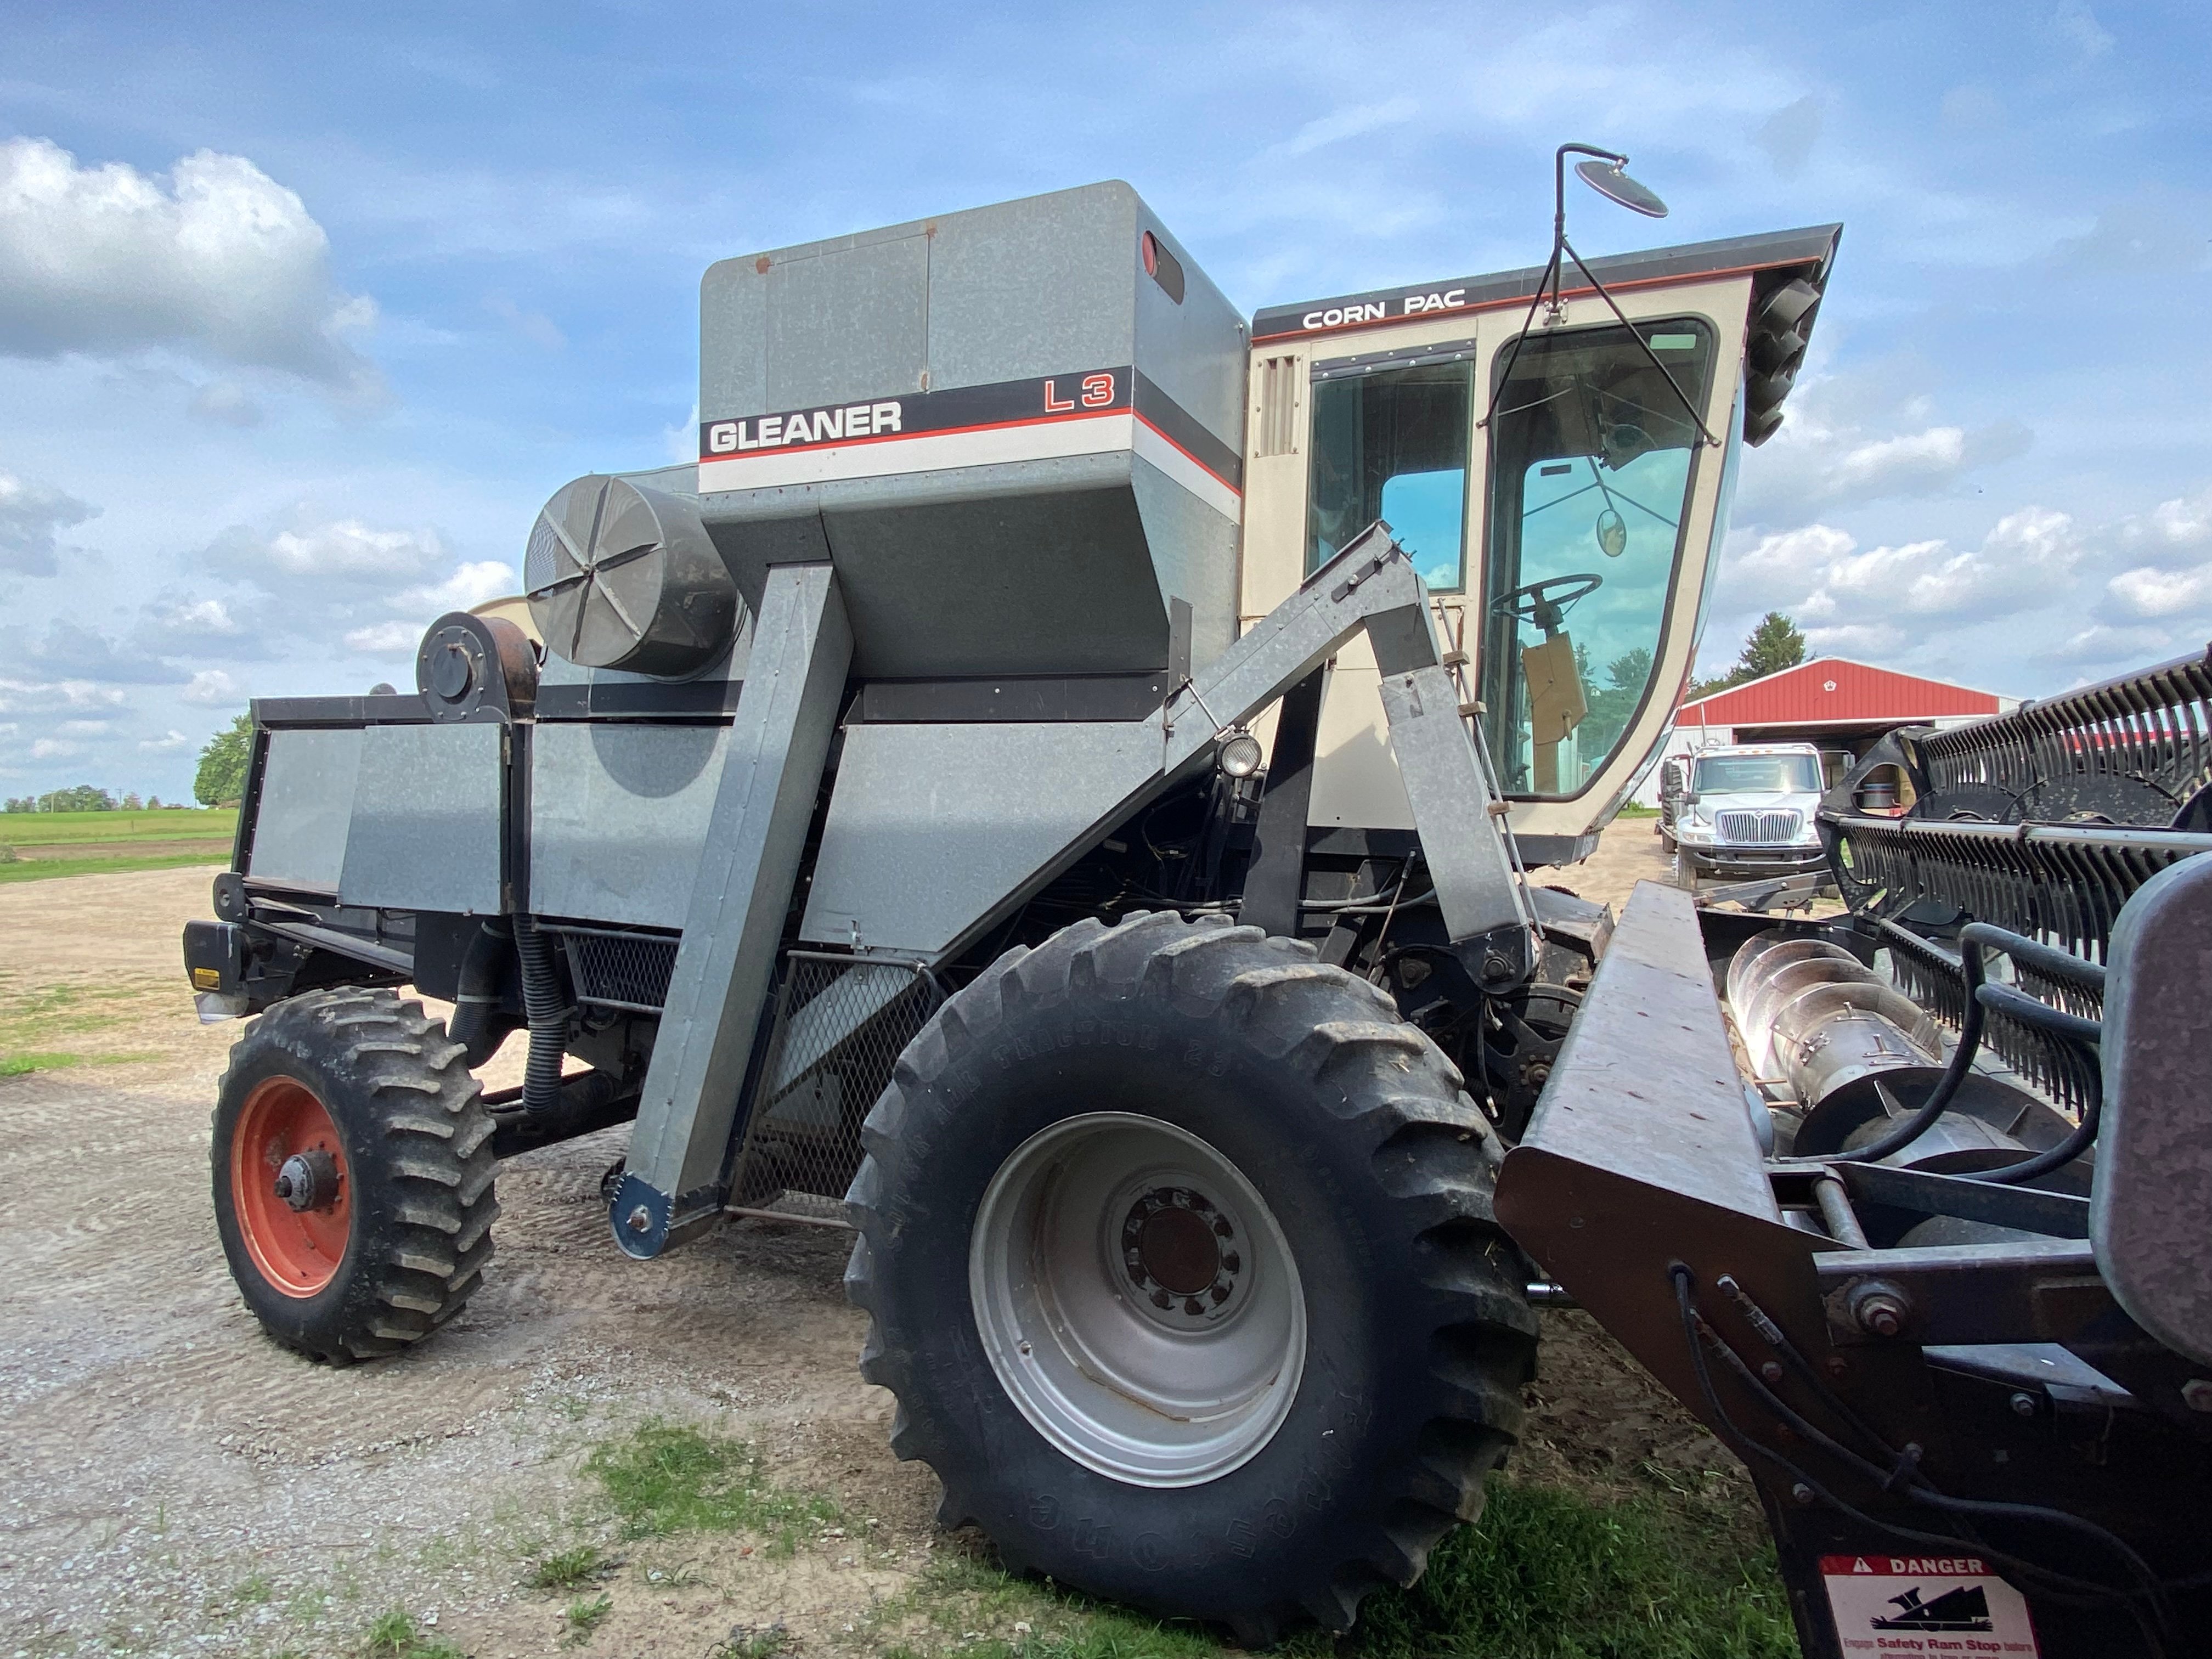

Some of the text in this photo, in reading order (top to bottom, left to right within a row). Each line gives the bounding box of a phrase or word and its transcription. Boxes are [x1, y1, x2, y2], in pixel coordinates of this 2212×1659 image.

[1302, 289, 1465, 329] CORN PAC
[1045, 374, 1114, 412] L 3
[710, 402, 902, 453] GLEANER
[991, 1022, 1161, 1070] TRACTION
[1890, 1559, 1984, 1574] DANGER
[1877, 1638, 1923, 1650] Safety
[1927, 1639, 1962, 1650] Ram
[1966, 1639, 2002, 1652] Stop
